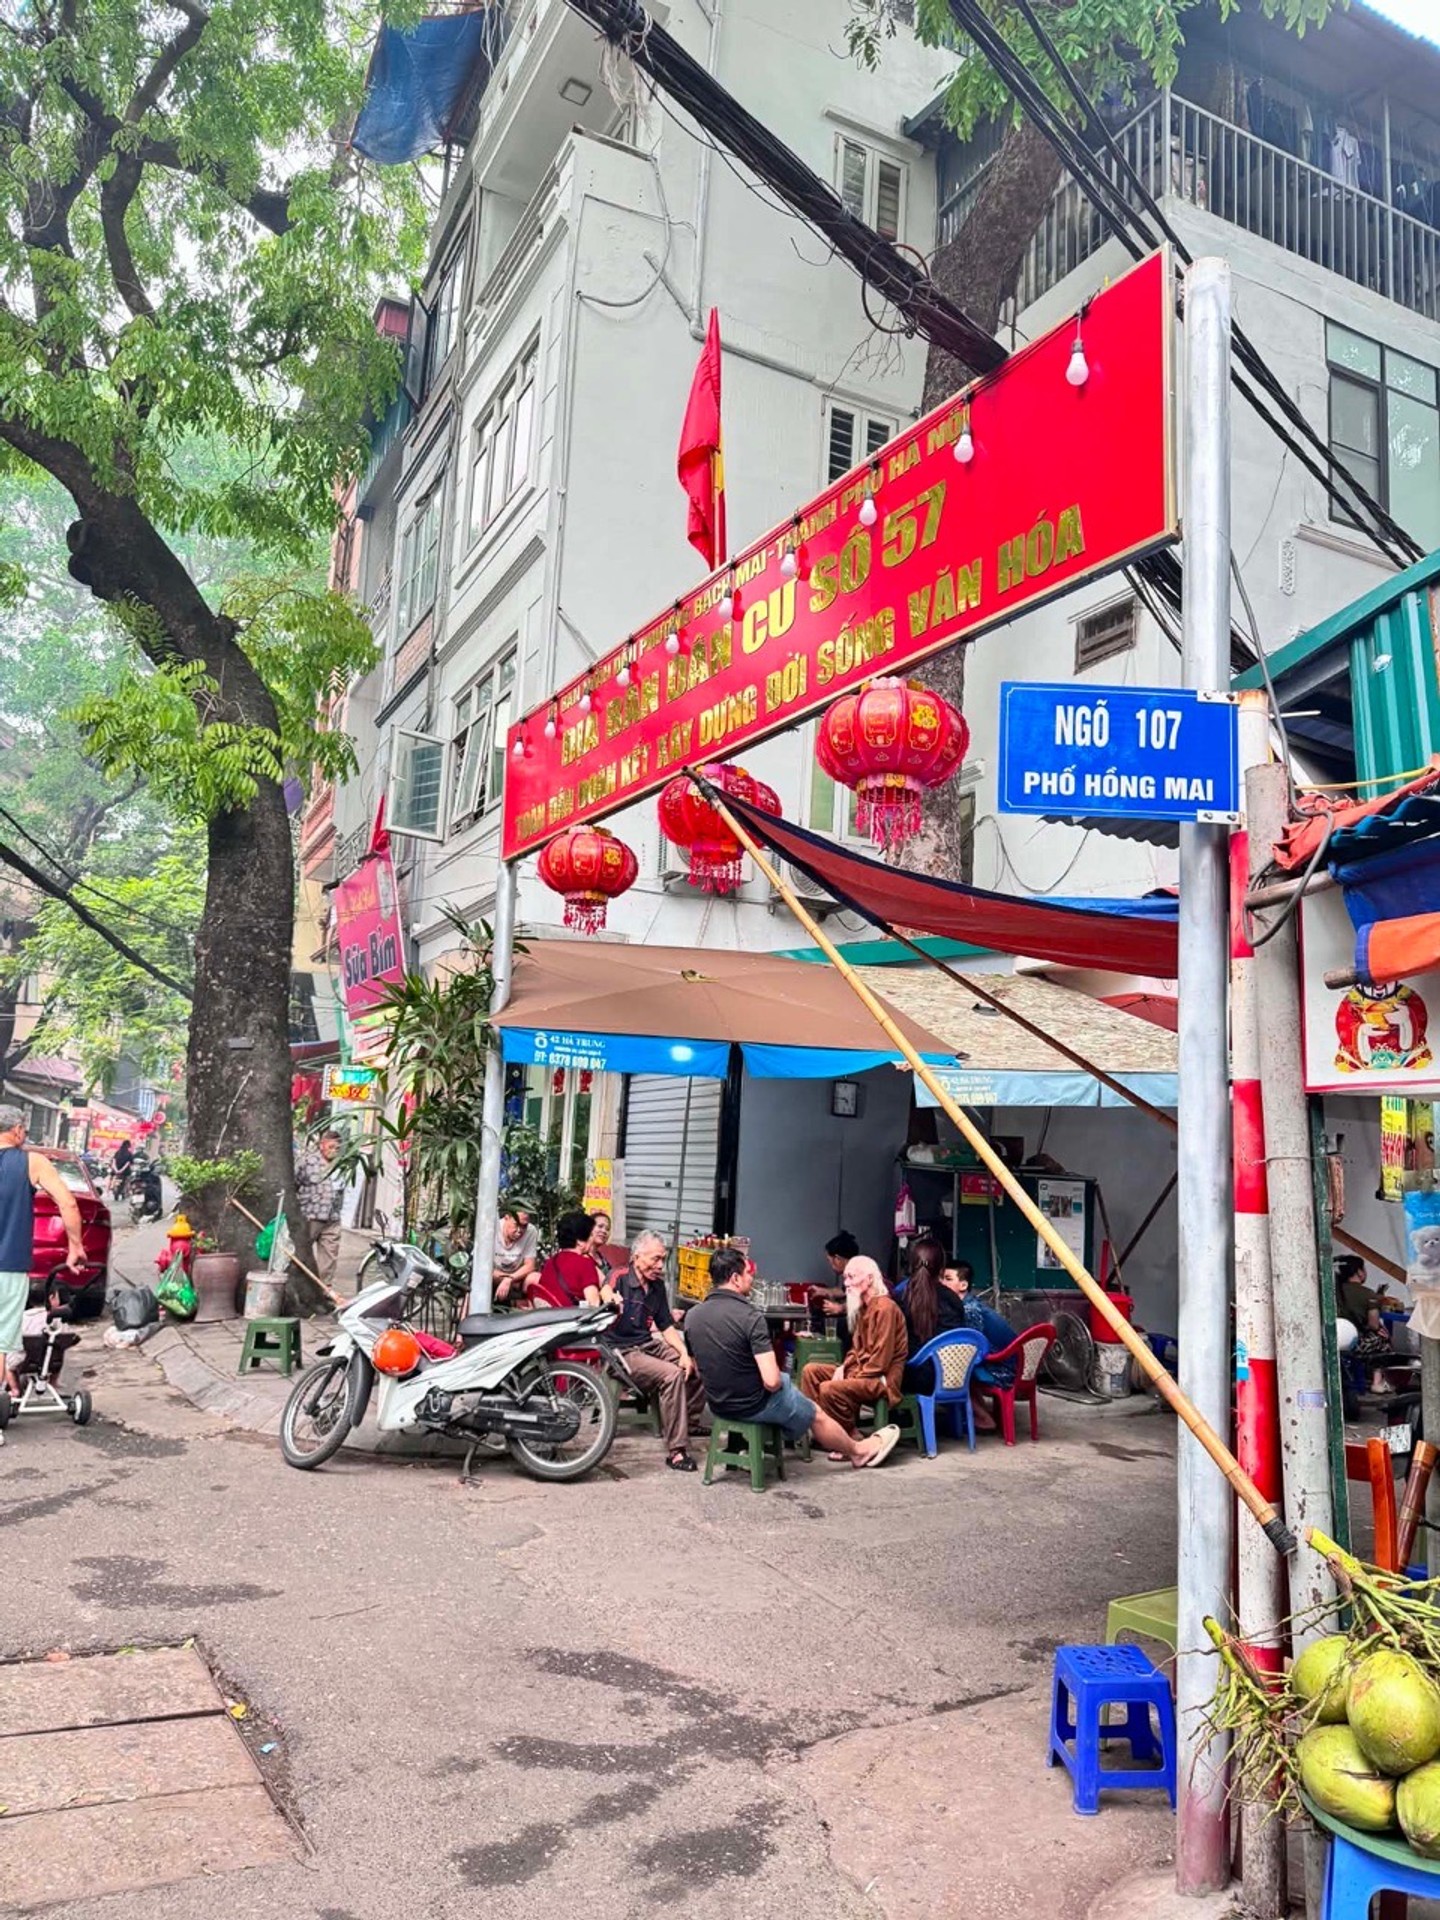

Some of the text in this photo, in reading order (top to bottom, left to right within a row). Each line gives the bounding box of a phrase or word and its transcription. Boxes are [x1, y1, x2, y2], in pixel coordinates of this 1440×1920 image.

[666, 618, 733, 705] DÂN
[882, 478, 947, 568] 57
[699, 683, 758, 750] DỰNG
[816, 610, 897, 686] SỐNG
[907, 565, 983, 638] VĂN
[997, 502, 1087, 594] HÓA
[1023, 764, 1214, 802] PHỐ HỒNG MAI
[1054, 699, 1183, 750] NGÕ 107
